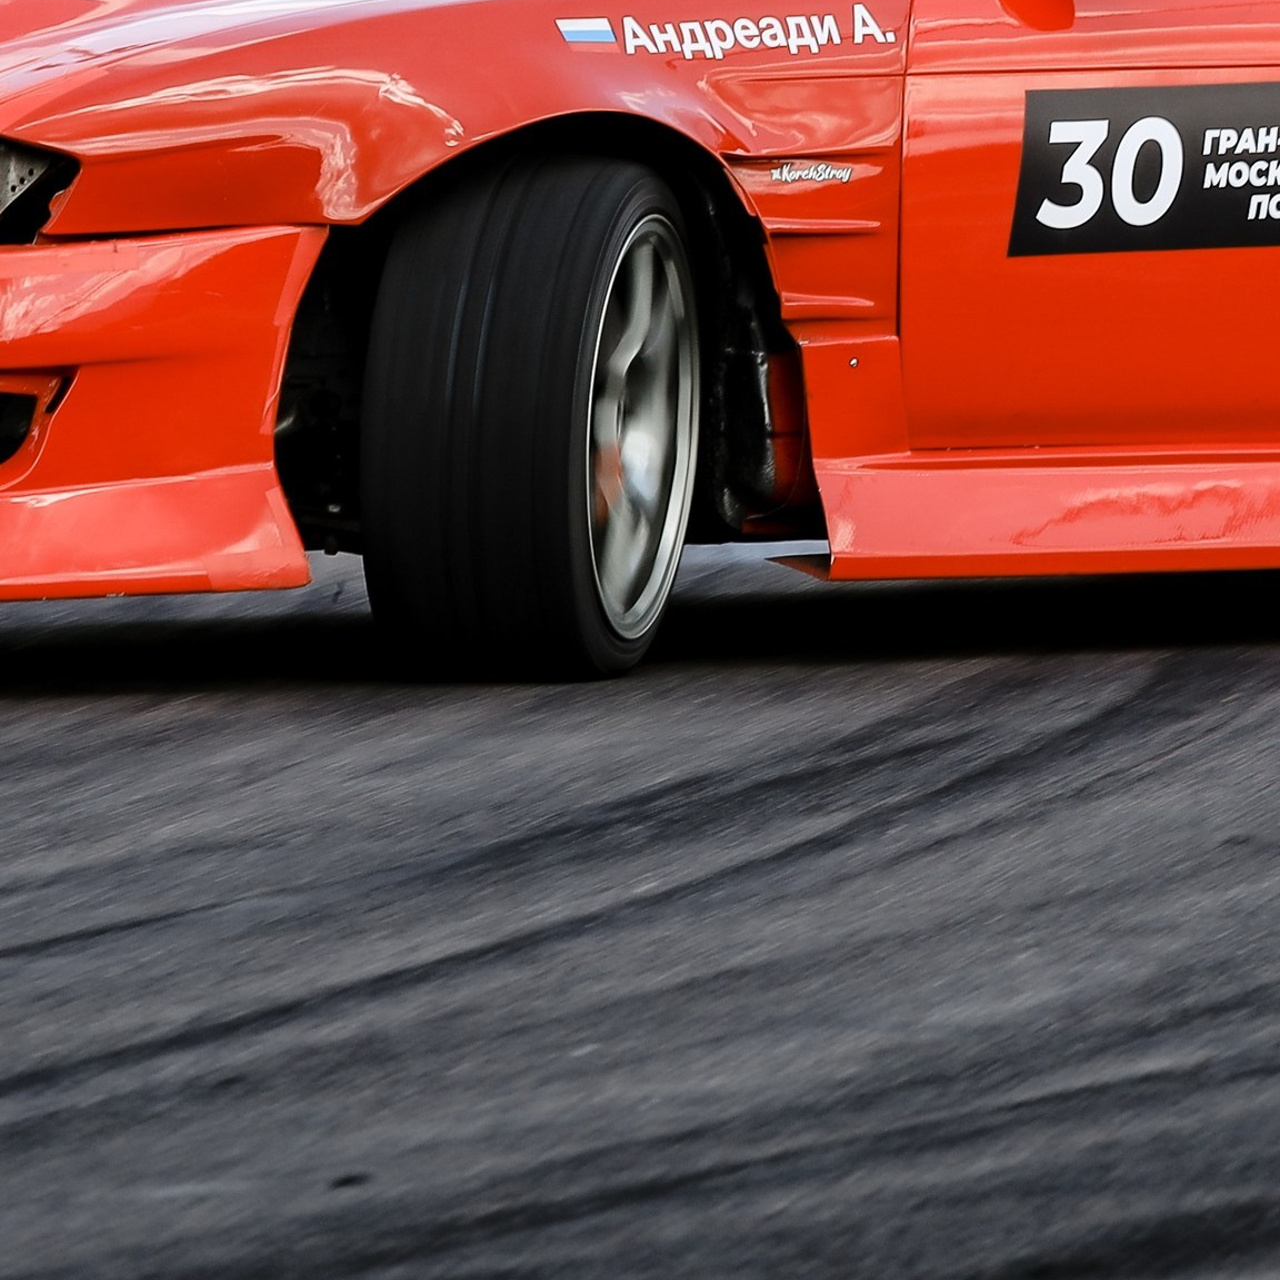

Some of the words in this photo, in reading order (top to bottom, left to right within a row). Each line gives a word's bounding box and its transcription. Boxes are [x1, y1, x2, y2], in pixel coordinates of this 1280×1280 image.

[622, 13, 842, 59] Андреади
[853, 3, 897, 44] А.
[1035, 115, 1184, 229] 30
